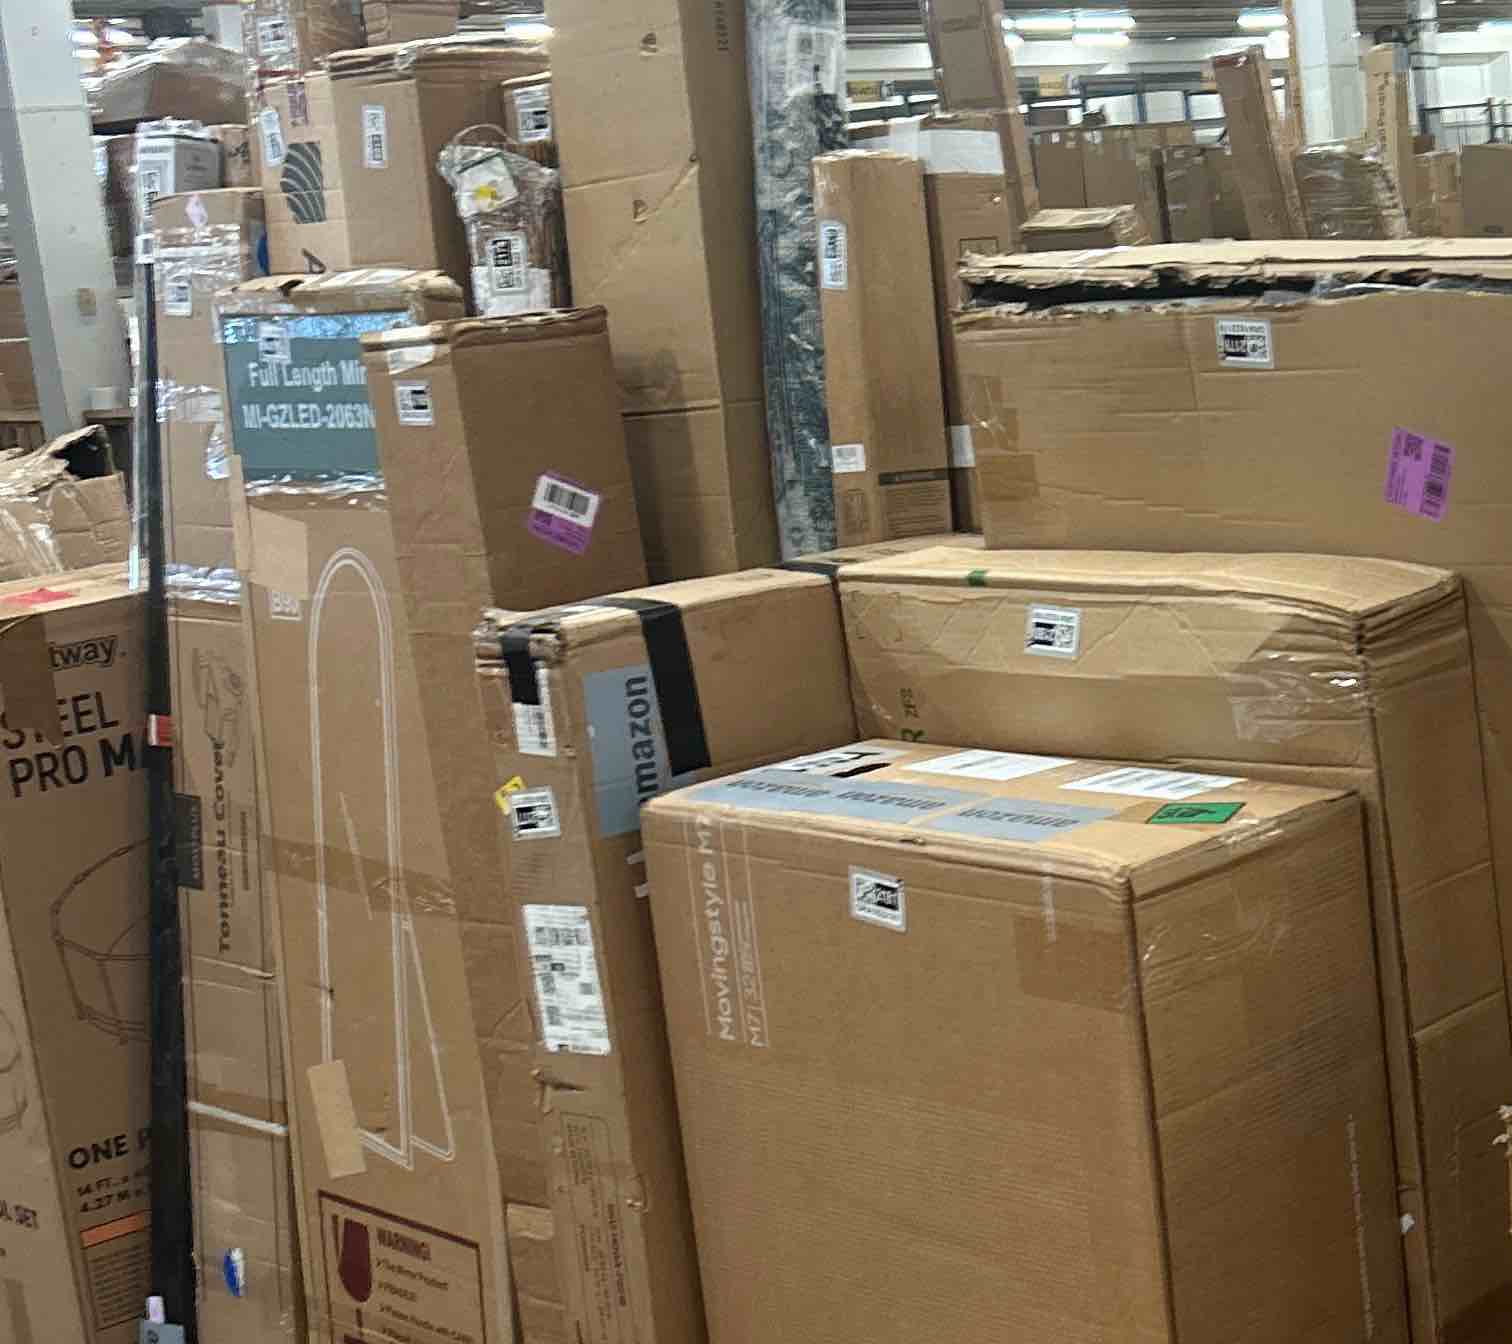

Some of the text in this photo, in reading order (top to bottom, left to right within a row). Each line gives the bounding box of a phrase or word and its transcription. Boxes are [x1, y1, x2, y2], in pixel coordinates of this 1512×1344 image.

[248, 360, 279, 387] Full
[283, 360, 338, 392] Length
[625, 675, 660, 806] mazon
[9, 744, 88, 797] PRO
[838, 789, 946, 813] amazon
[959, 807, 1080, 828] amazon
[213, 739, 231, 954] Tonneau Cover
[68, 1134, 129, 1170] ONE
